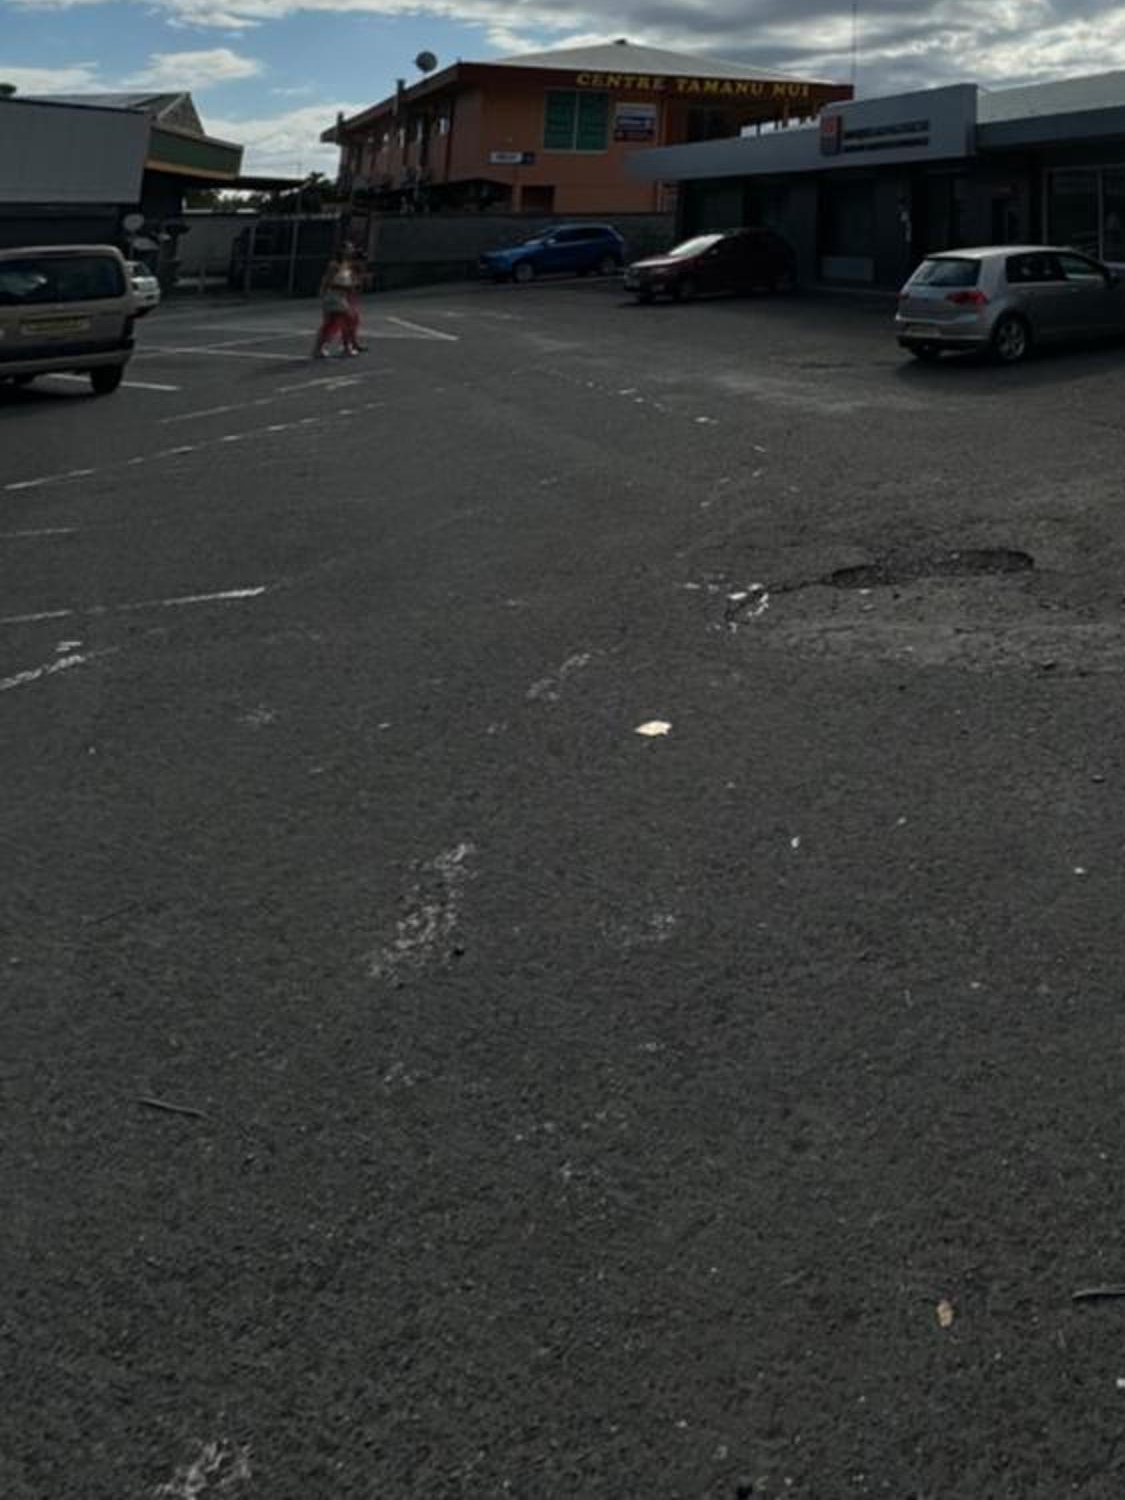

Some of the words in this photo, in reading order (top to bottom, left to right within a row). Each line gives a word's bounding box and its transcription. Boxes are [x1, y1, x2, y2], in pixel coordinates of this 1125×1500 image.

[576, 72, 666, 91] CENTRE
[676, 78, 763, 96] TAMANU
[772, 82, 809, 97] NUI
